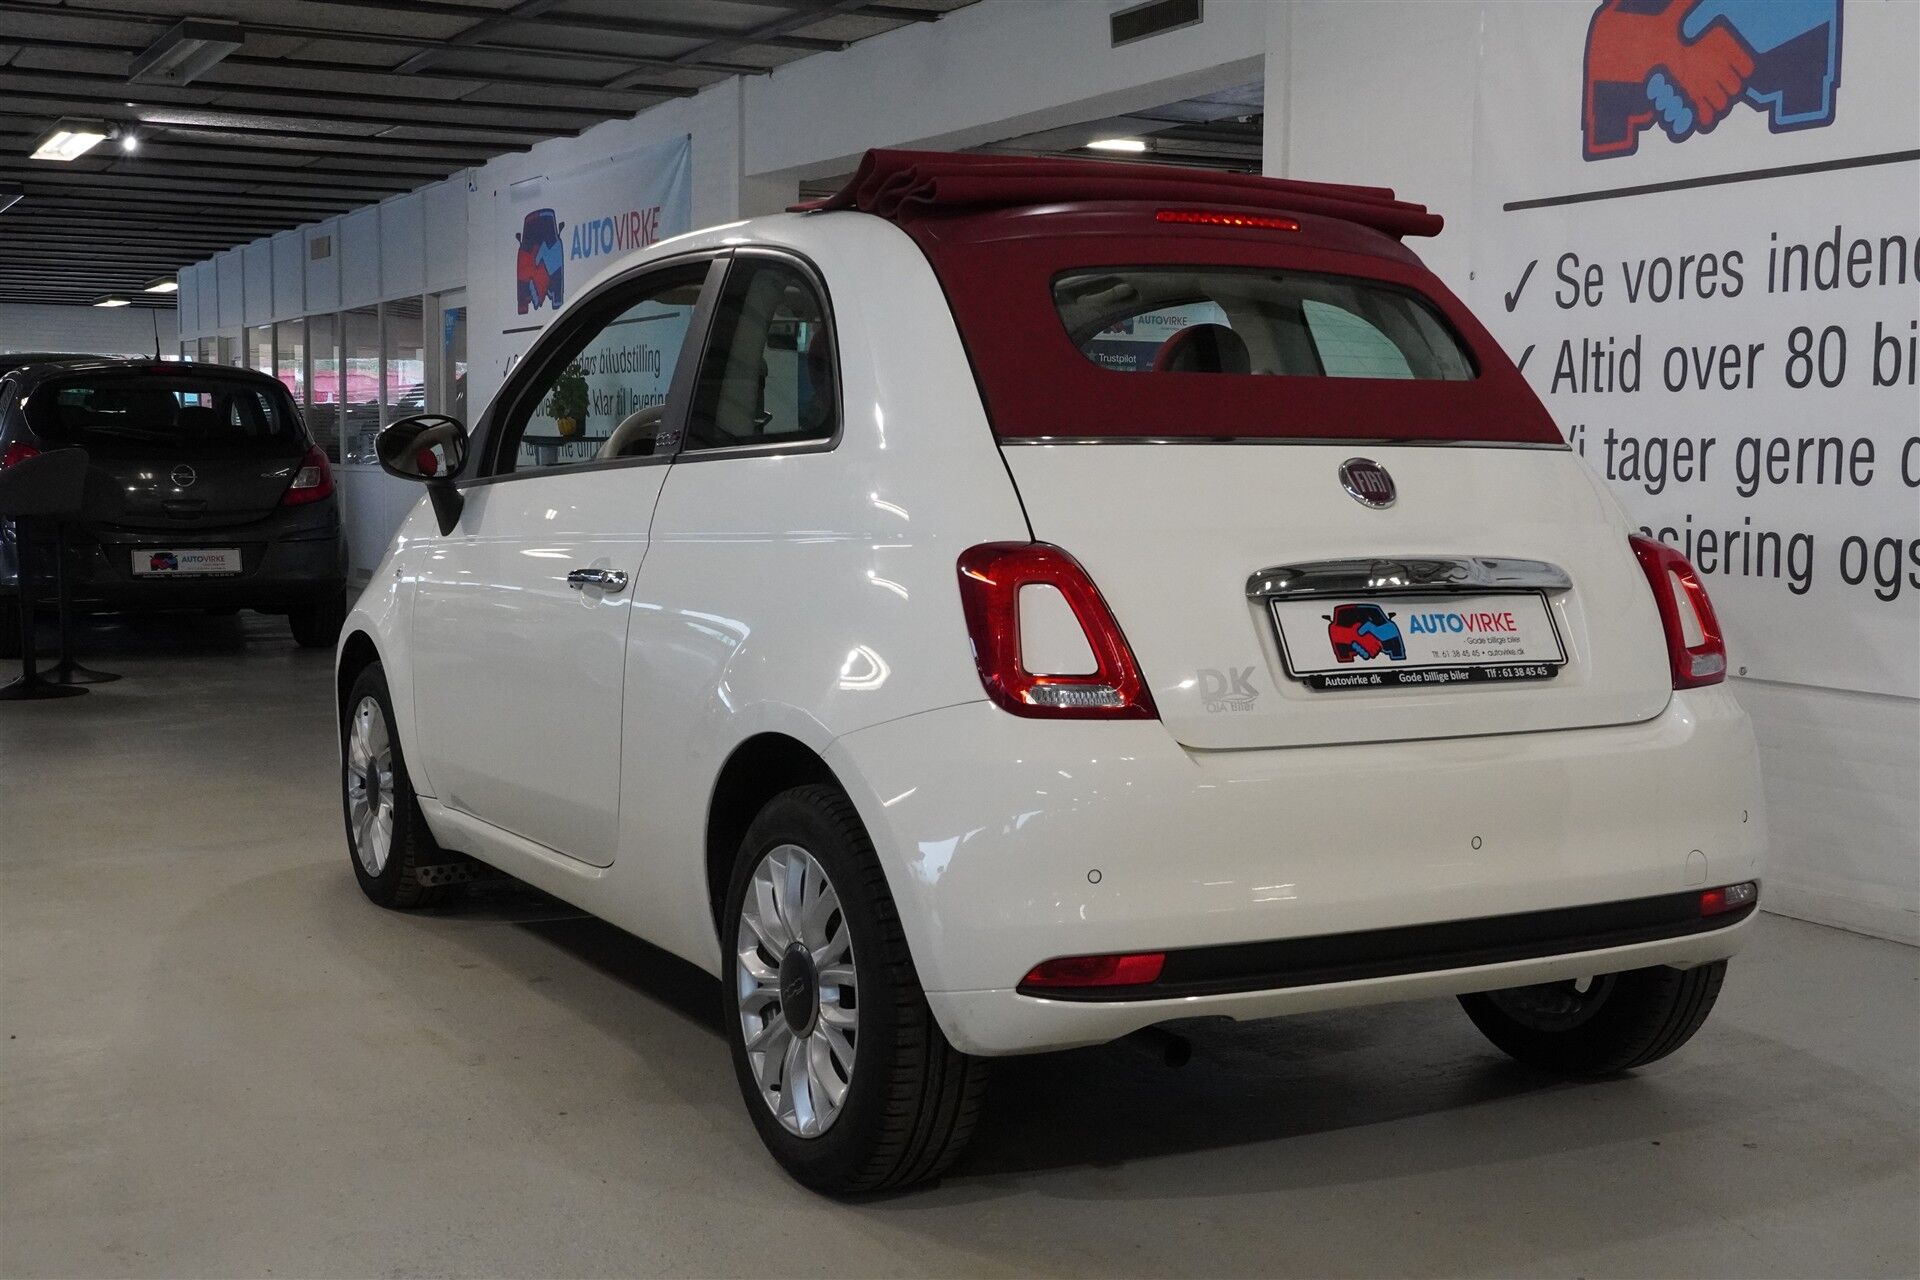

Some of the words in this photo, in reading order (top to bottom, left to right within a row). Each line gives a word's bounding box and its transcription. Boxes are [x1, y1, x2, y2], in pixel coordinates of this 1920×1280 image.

[571, 206, 660, 260] AUTOVIRKE
[1555, 252, 1603, 309] Se
[1622, 250, 1744, 303] vores
[1138, 315, 1187, 326] AUTOVIRKE
[600, 343, 660, 379] biludstilling
[1099, 353, 1137, 364] Trustpilot
[1550, 334, 1641, 394] Altid
[1663, 343, 1764, 392] over
[1785, 325, 1846, 389] 80
[593, 388, 614, 416] klar
[617, 387, 626, 415] til
[1604, 428, 1716, 495] tager
[1736, 437, 1875, 498] gerne
[181, 555, 225, 563] AUTOVIRKE
[1410, 613, 1517, 634] AUTOVIRKE
[1325, 675, 1368, 686] Autovirke
[1370, 674, 1382, 684] dk
[1399, 672, 1422, 682] Gode
[1423, 671, 1449, 683] billige
[1450, 670, 1469, 680] biler
[1502, 668, 1513, 677] 61
[1514, 667, 1525, 677] 38
[1526, 667, 1536, 676] 45
[1537, 666, 1548, 675] 45
